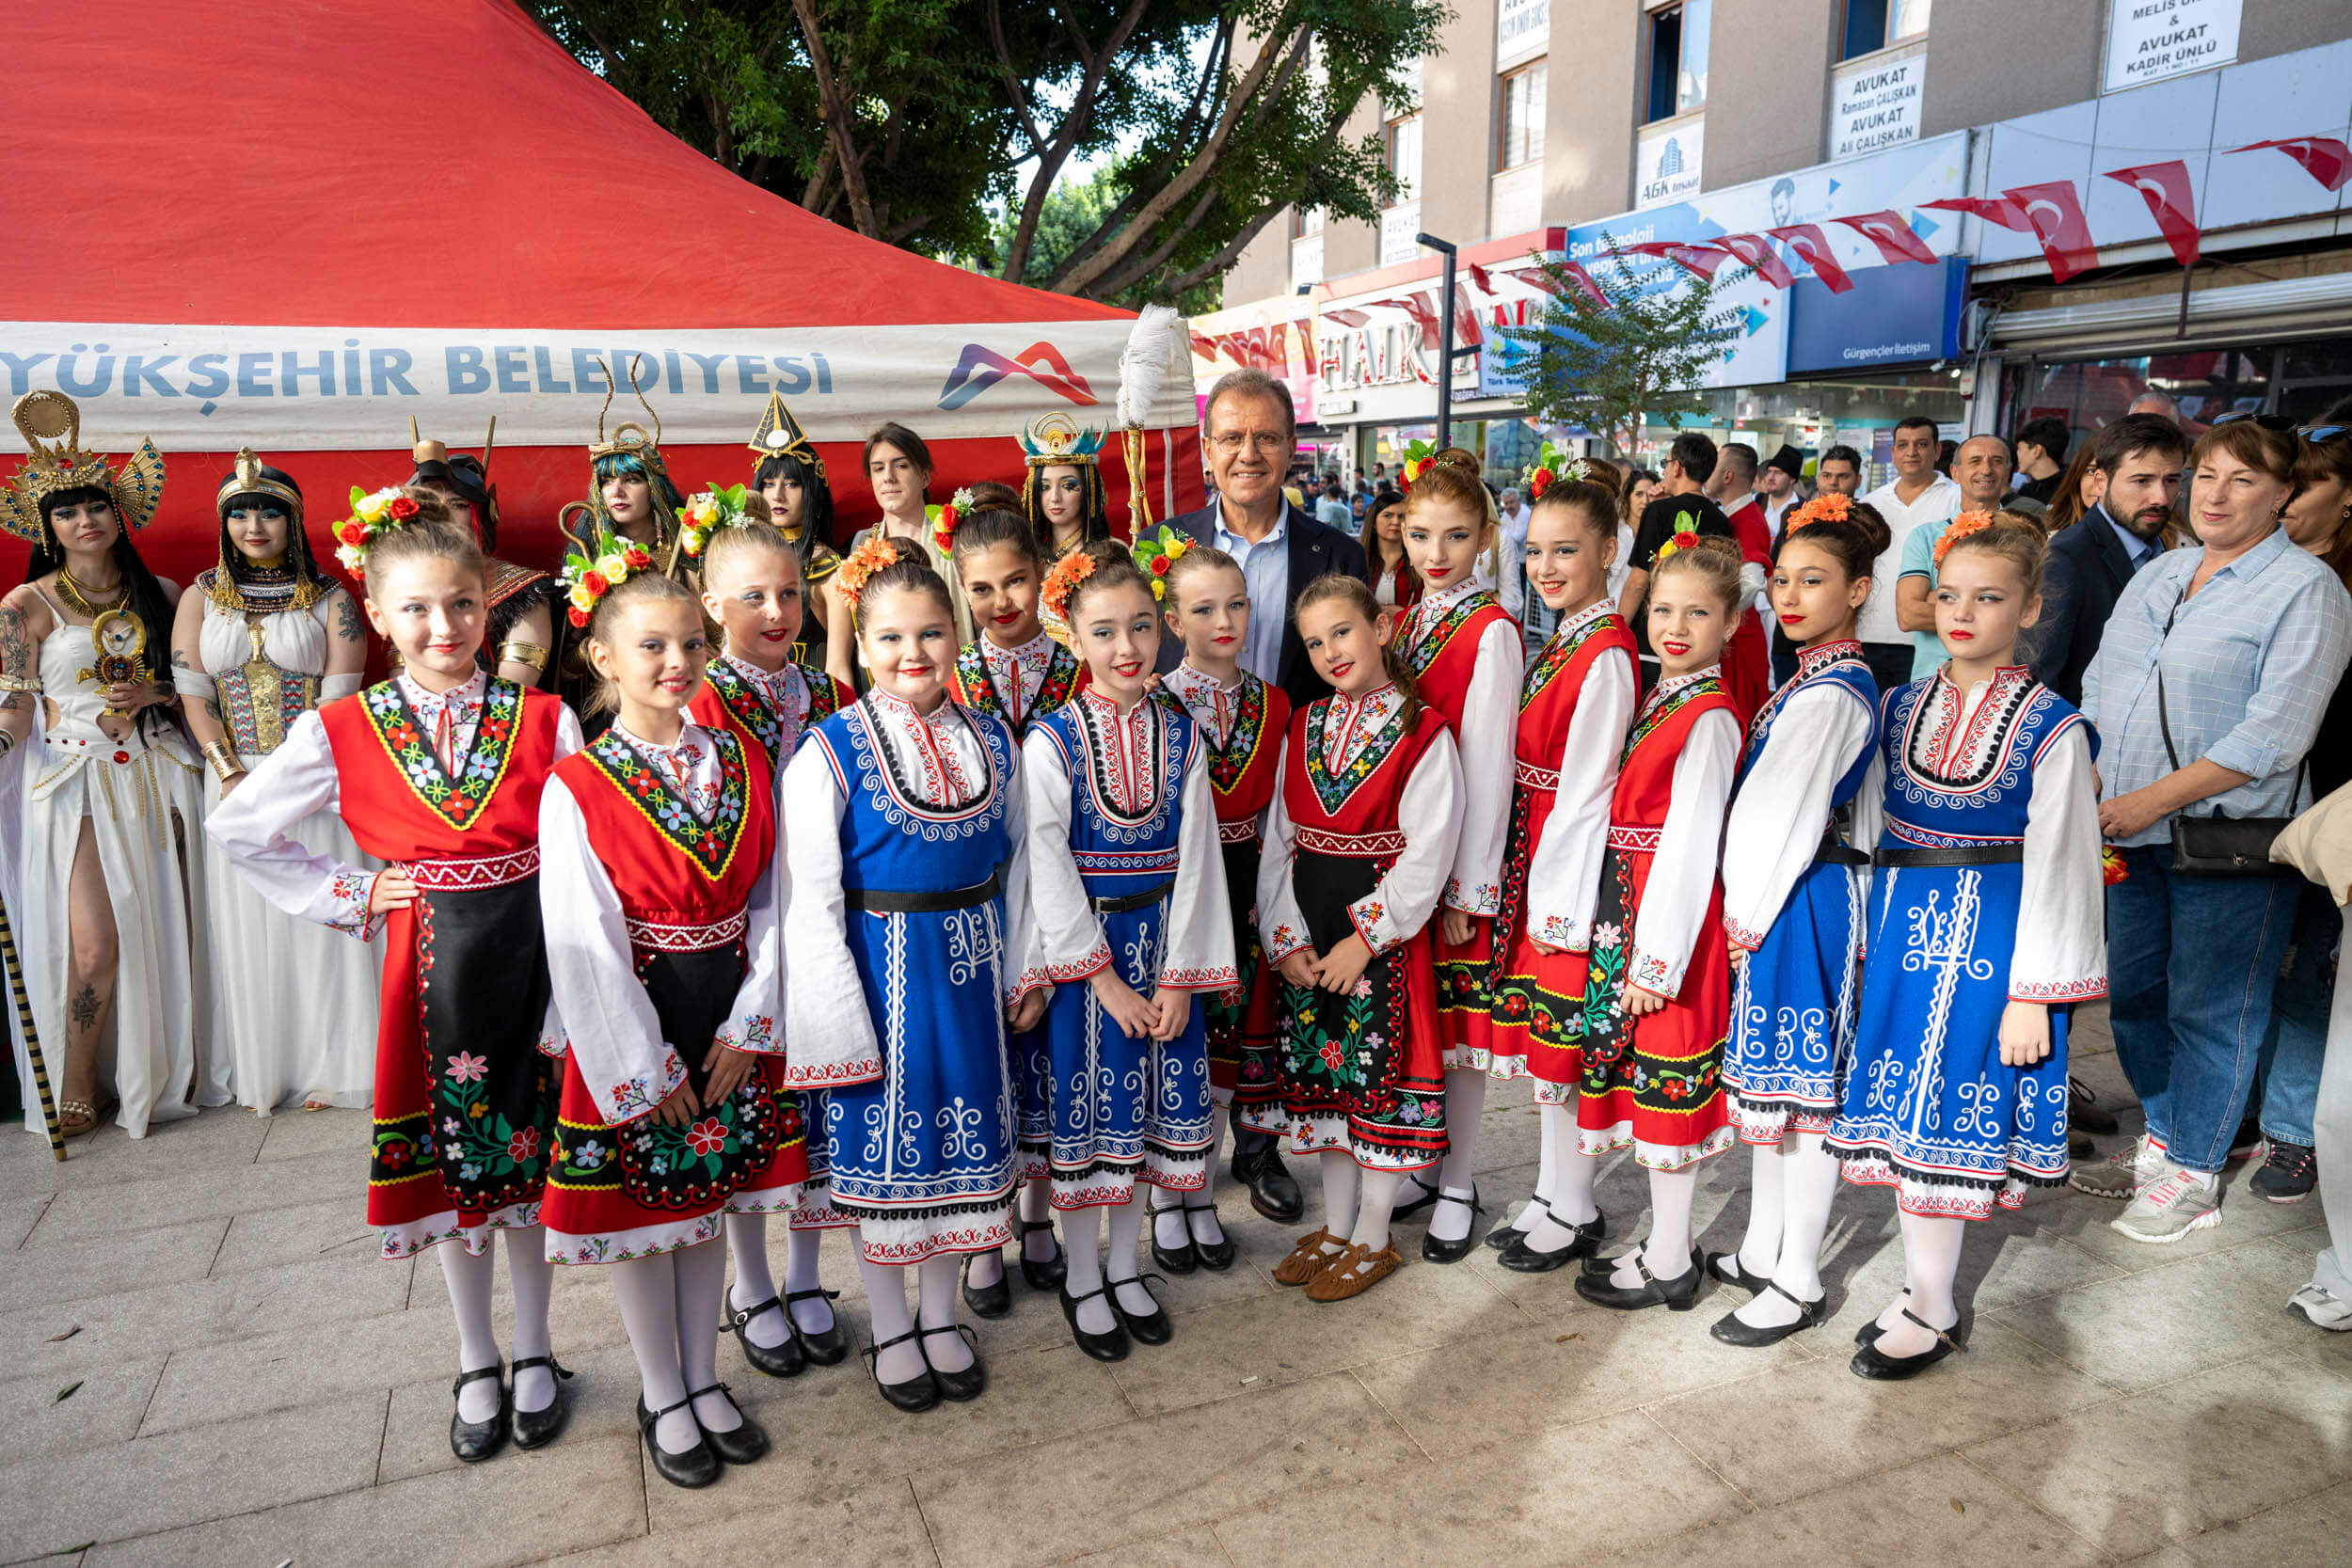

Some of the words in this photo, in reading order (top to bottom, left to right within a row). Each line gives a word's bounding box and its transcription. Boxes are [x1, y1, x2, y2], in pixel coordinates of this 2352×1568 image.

[2169, 14, 2180, 26] &
[2138, 24, 2209, 54] AVUKAT
[2126, 52, 2170, 74] KADİR
[2175, 40, 2217, 60] ÜNLÜ
[1853, 67, 1908, 95] AVUKAT
[1842, 99, 1875, 114] Ramazan
[1876, 83, 1917, 106] ÇALIŞKAN
[1851, 106, 1905, 134] AVUKAT
[1839, 140, 1853, 154] Ali
[1856, 125, 1913, 150] ÇALIŞKAN
[1641, 181, 1669, 201] AGK
[1569, 239, 1594, 259] Son
[1595, 226, 1655, 252] tenoloji
[0, 338, 421, 417] YÜKŞEHİR
[444, 345, 834, 395] BELEDİYESİ
